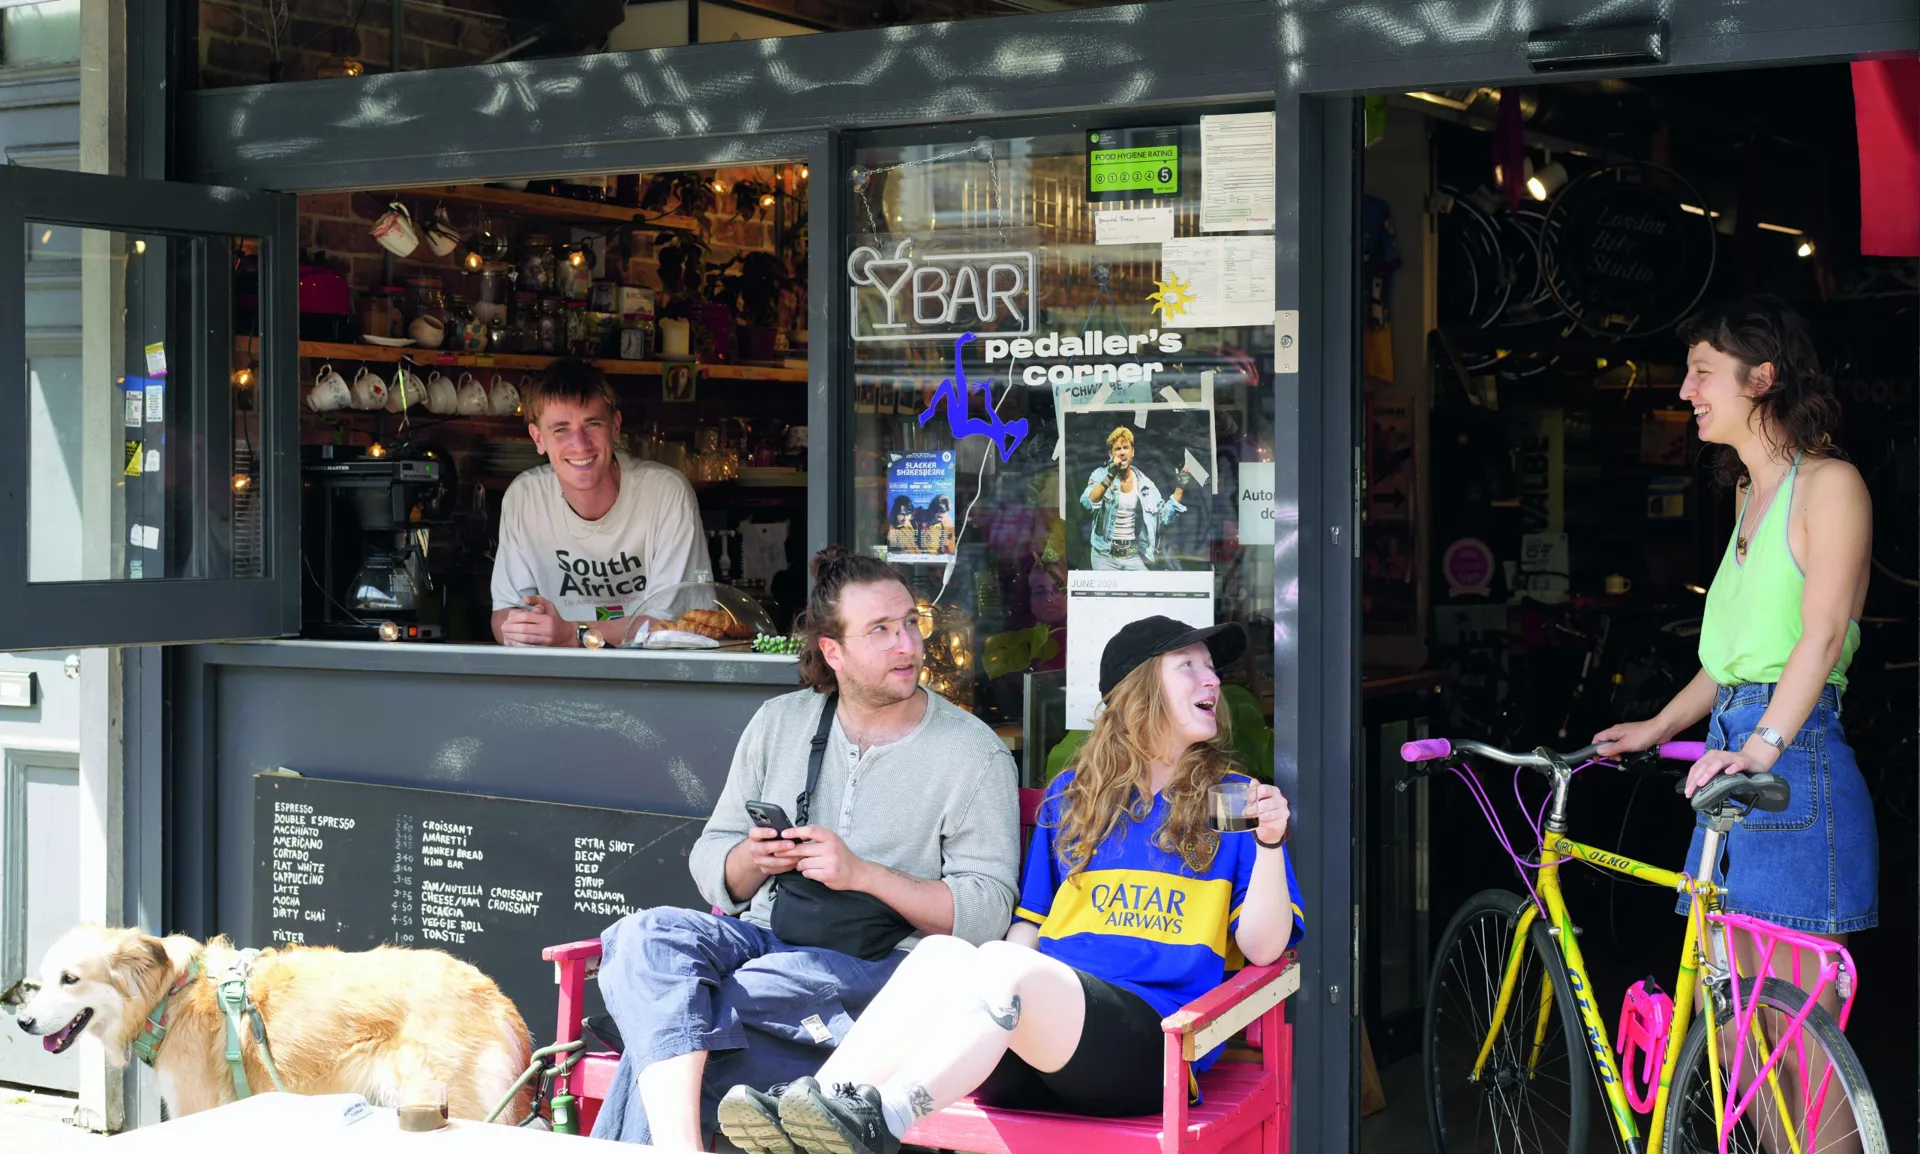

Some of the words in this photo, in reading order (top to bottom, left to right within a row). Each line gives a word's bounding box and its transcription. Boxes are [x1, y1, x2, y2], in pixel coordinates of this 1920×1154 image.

[1095, 153, 1116, 161] FOOD
[1117, 151, 1147, 160] HYGIENE
[1148, 149, 1173, 158] RATING
[1161, 169, 1169, 182] 5
[912, 264, 1025, 325] BAR
[984, 330, 1183, 364] pedaller's
[1022, 361, 1164, 387] corner
[1065, 380, 1123, 398] CHWBE
[1242, 489, 1275, 501] Auto
[556, 550, 642, 578] South
[559, 572, 647, 597] Africa
[1072, 580, 1095, 588] JUNE
[274, 802, 314, 814] ESPRESSO
[274, 813, 306, 824] DOUBLE
[311, 816, 355, 830] ESPRESSO
[421, 846, 455, 857] MONKEY
[456, 848, 484, 861] BREAD
[574, 837, 605, 850] EXTRA
[608, 840, 635, 854] SHOT
[273, 848, 309, 862] CORTADO
[574, 850, 606, 862] DECAF
[1589, 851, 1630, 870] OLMO
[273, 860, 293, 871] FLAT
[447, 860, 464, 870] BAR
[575, 863, 599, 874] ICED
[273, 884, 300, 895] LATTE
[574, 876, 605, 889] SYRUP
[421, 880, 483, 896] JAM/NUTELLA
[490, 887, 543, 902] CROISSANT
[574, 889, 625, 903] CARDAMOM
[272, 896, 300, 906] MOCHA
[421, 891, 480, 908] CHEESE/HAM
[488, 899, 540, 917] CROISSANT
[1091, 883, 1186, 917] QATAR
[573, 901, 642, 917] MARSHMALL
[421, 916, 457, 930] VEGGIE
[460, 920, 484, 933] ROLL
[1104, 911, 1183, 934] AIRWAYS
[421, 928, 466, 944] TOASTIE
